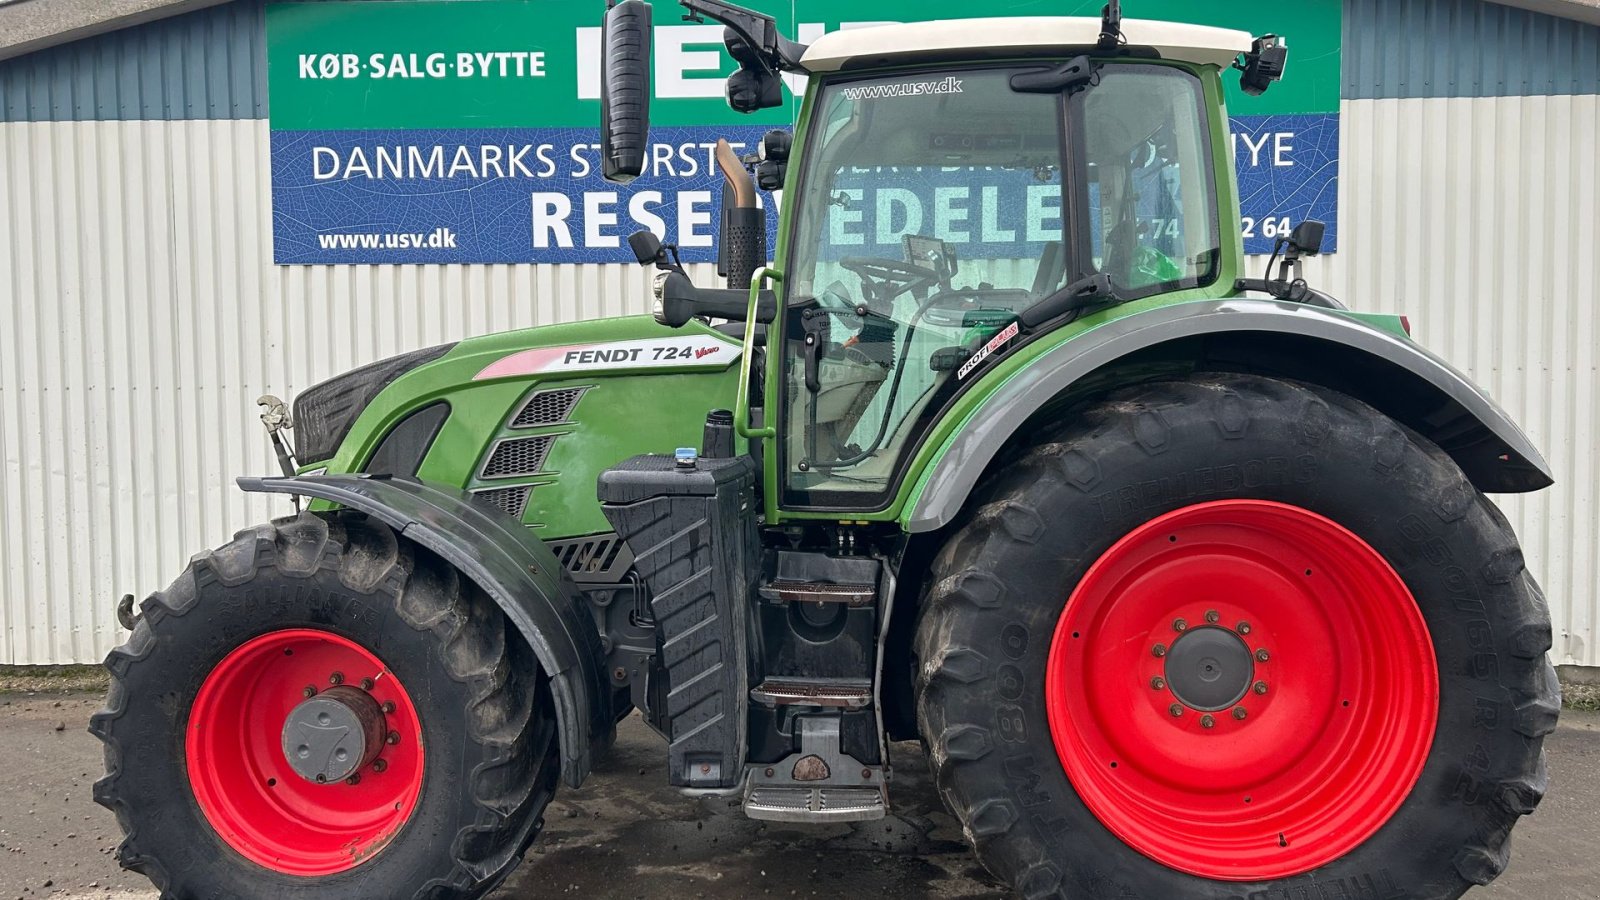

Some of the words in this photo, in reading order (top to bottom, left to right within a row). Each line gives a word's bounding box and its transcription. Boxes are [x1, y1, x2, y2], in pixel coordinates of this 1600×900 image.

[844, 77, 963, 100] www.usv.dk
[312, 145, 556, 179] DANMARKS
[571, 142, 746, 177] SRST
[1231, 132, 1294, 166] YE
[318, 227, 456, 249] www.usv.dk
[1151, 217, 1180, 239] 74
[1262, 216, 1291, 238] 64
[564, 348, 643, 365] FENDT
[652, 346, 692, 361] 724
[1092, 453, 1318, 522] TRELLEBORG
[995, 621, 1031, 744] 800
